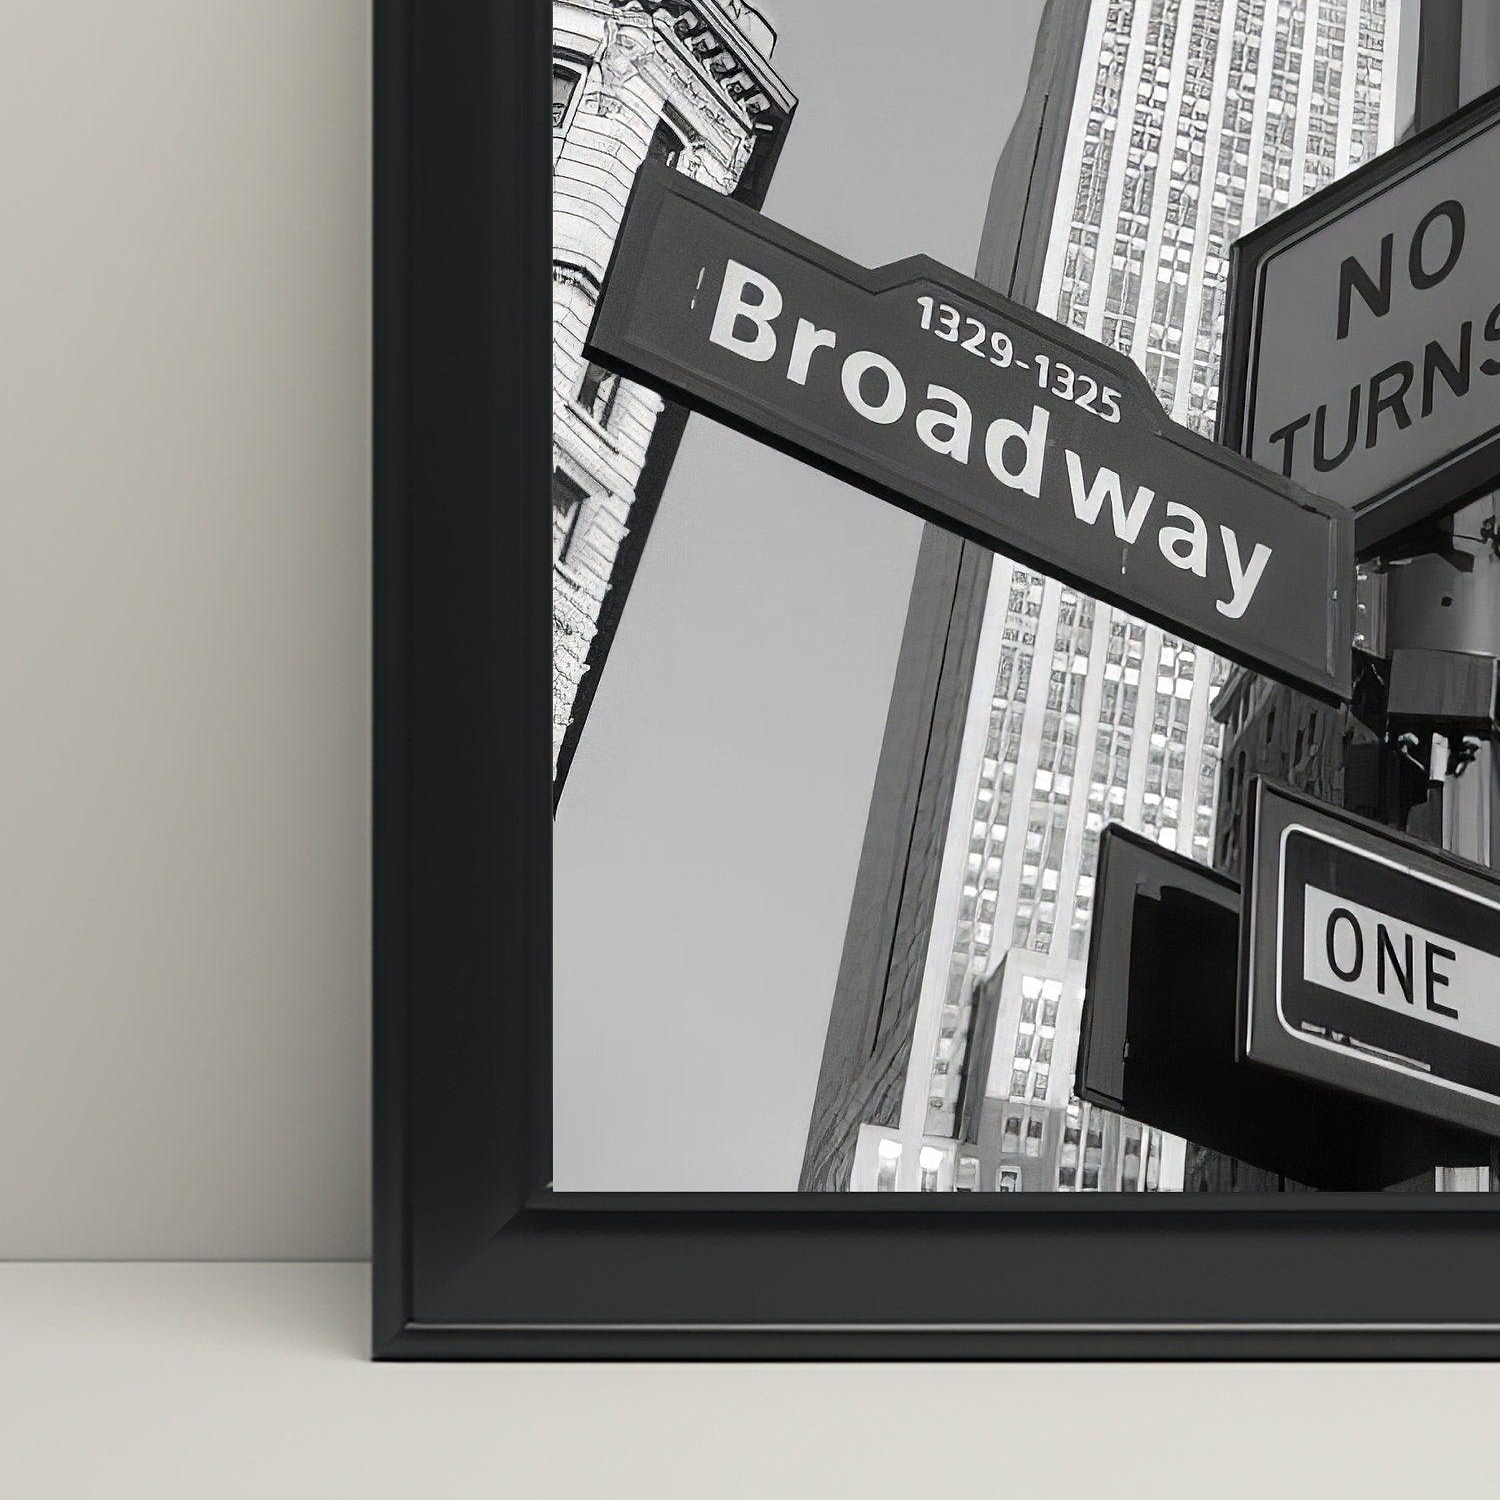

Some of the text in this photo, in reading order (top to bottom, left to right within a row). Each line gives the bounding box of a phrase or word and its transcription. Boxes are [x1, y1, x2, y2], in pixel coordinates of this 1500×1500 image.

[1336, 199, 1466, 341] NO
[916, 296, 1122, 424] 1329-1325
[709, 258, 1273, 619] Broadway
[1325, 907, 1459, 1020] ONE
